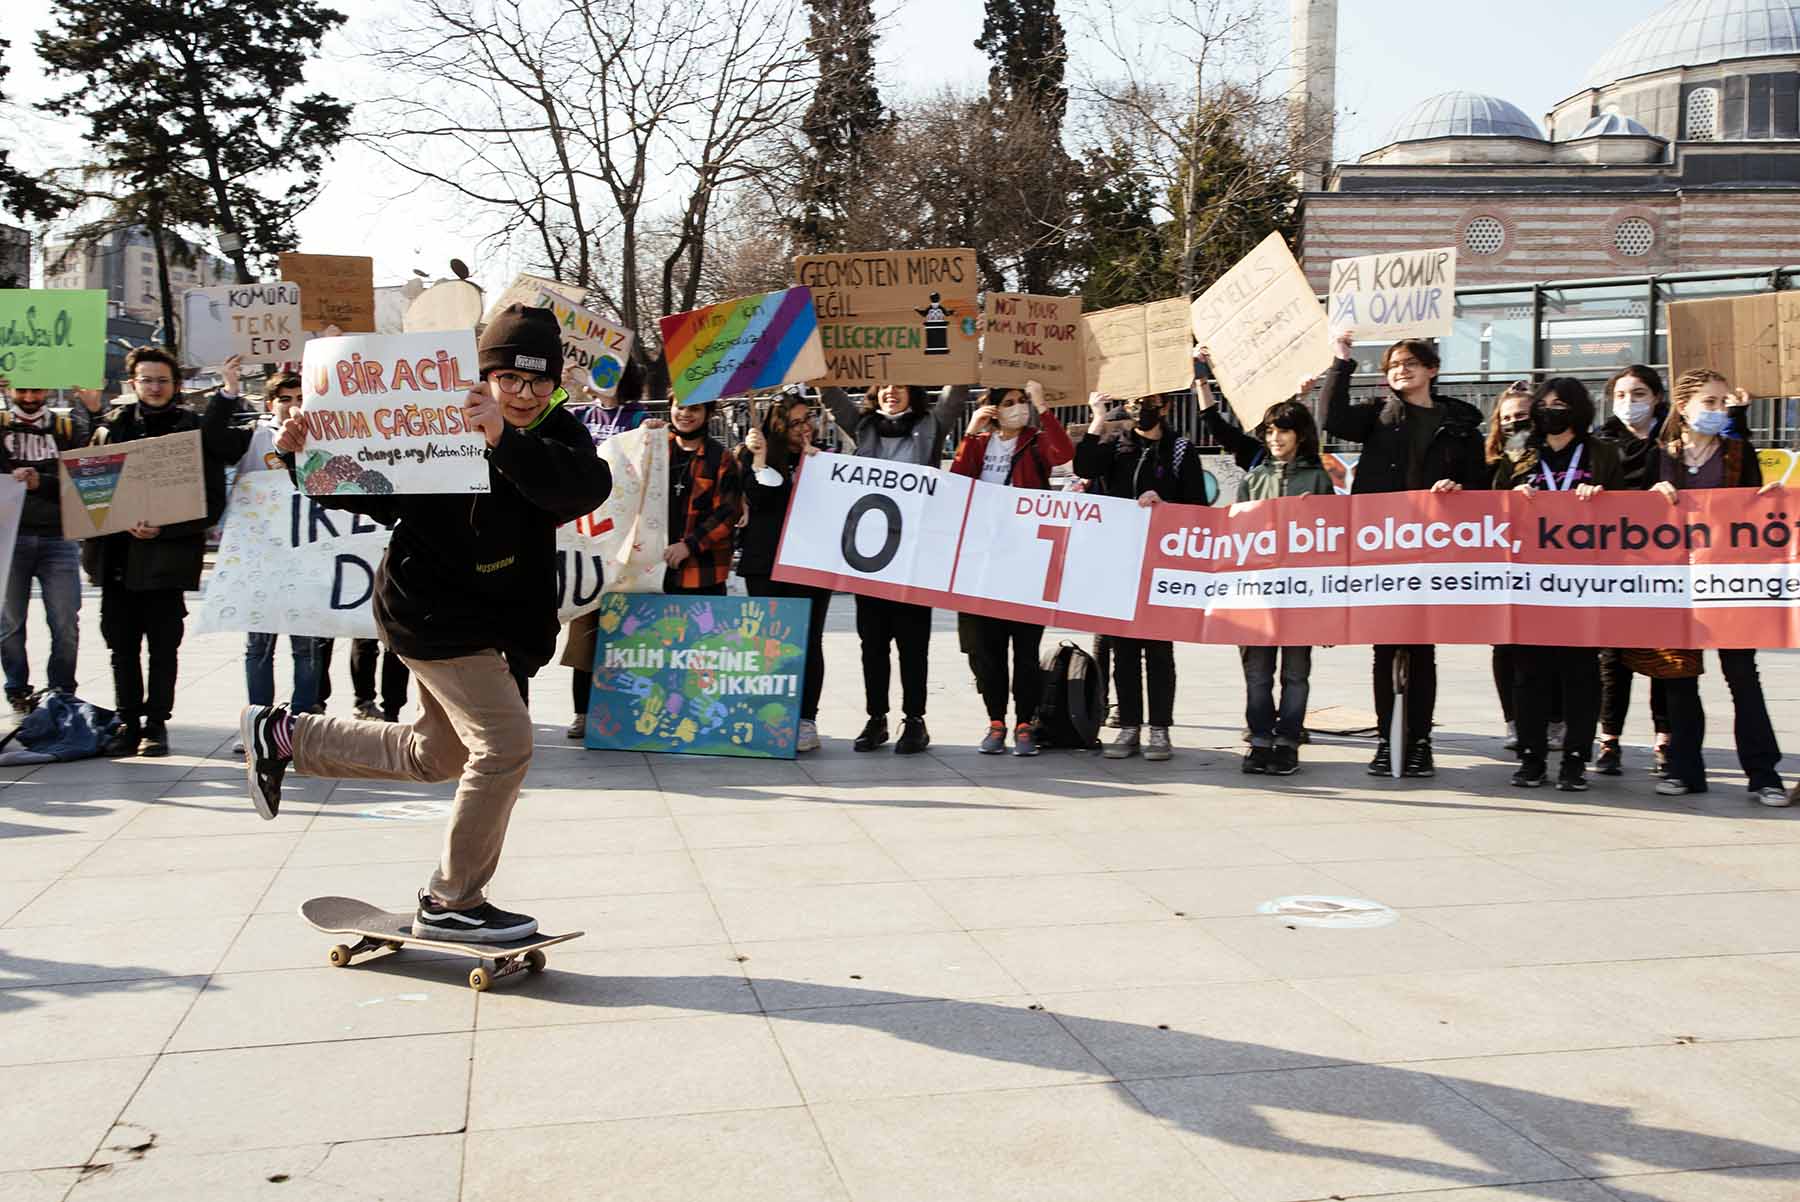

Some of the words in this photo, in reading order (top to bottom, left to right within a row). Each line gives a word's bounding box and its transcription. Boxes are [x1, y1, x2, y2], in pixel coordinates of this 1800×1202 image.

[906, 256, 964, 286] MİRAS
[1333, 260, 1361, 292] YA
[815, 290, 858, 319] EĞİL
[1331, 290, 1359, 325] YA
[231, 312, 292, 336] TERK
[822, 324, 921, 350] ELECEKTEN
[1043, 323, 1077, 342] YOUR
[336, 352, 389, 397] BİR
[391, 350, 475, 393] ACİL
[825, 352, 892, 380] MANET
[830, 462, 938, 497] KARBON
[1015, 494, 1104, 524] DÜNYA
[1159, 527, 1277, 566] dünya
[1288, 518, 1345, 553] bir
[1356, 515, 1522, 553] olacak,
[1538, 516, 1712, 550] karbon
[1730, 512, 1800, 548] nö
[1036, 523, 1072, 603] 1
[1157, 579, 1197, 597] sen
[1204, 580, 1229, 598] de
[1236, 576, 1314, 597] imzala,
[1321, 573, 1422, 594] liderlere
[1430, 570, 1532, 592] sesimizi
[1539, 573, 1684, 598] duyuralım:
[604, 643, 665, 669] İKLİM
[669, 645, 760, 672] KRİZİNE
